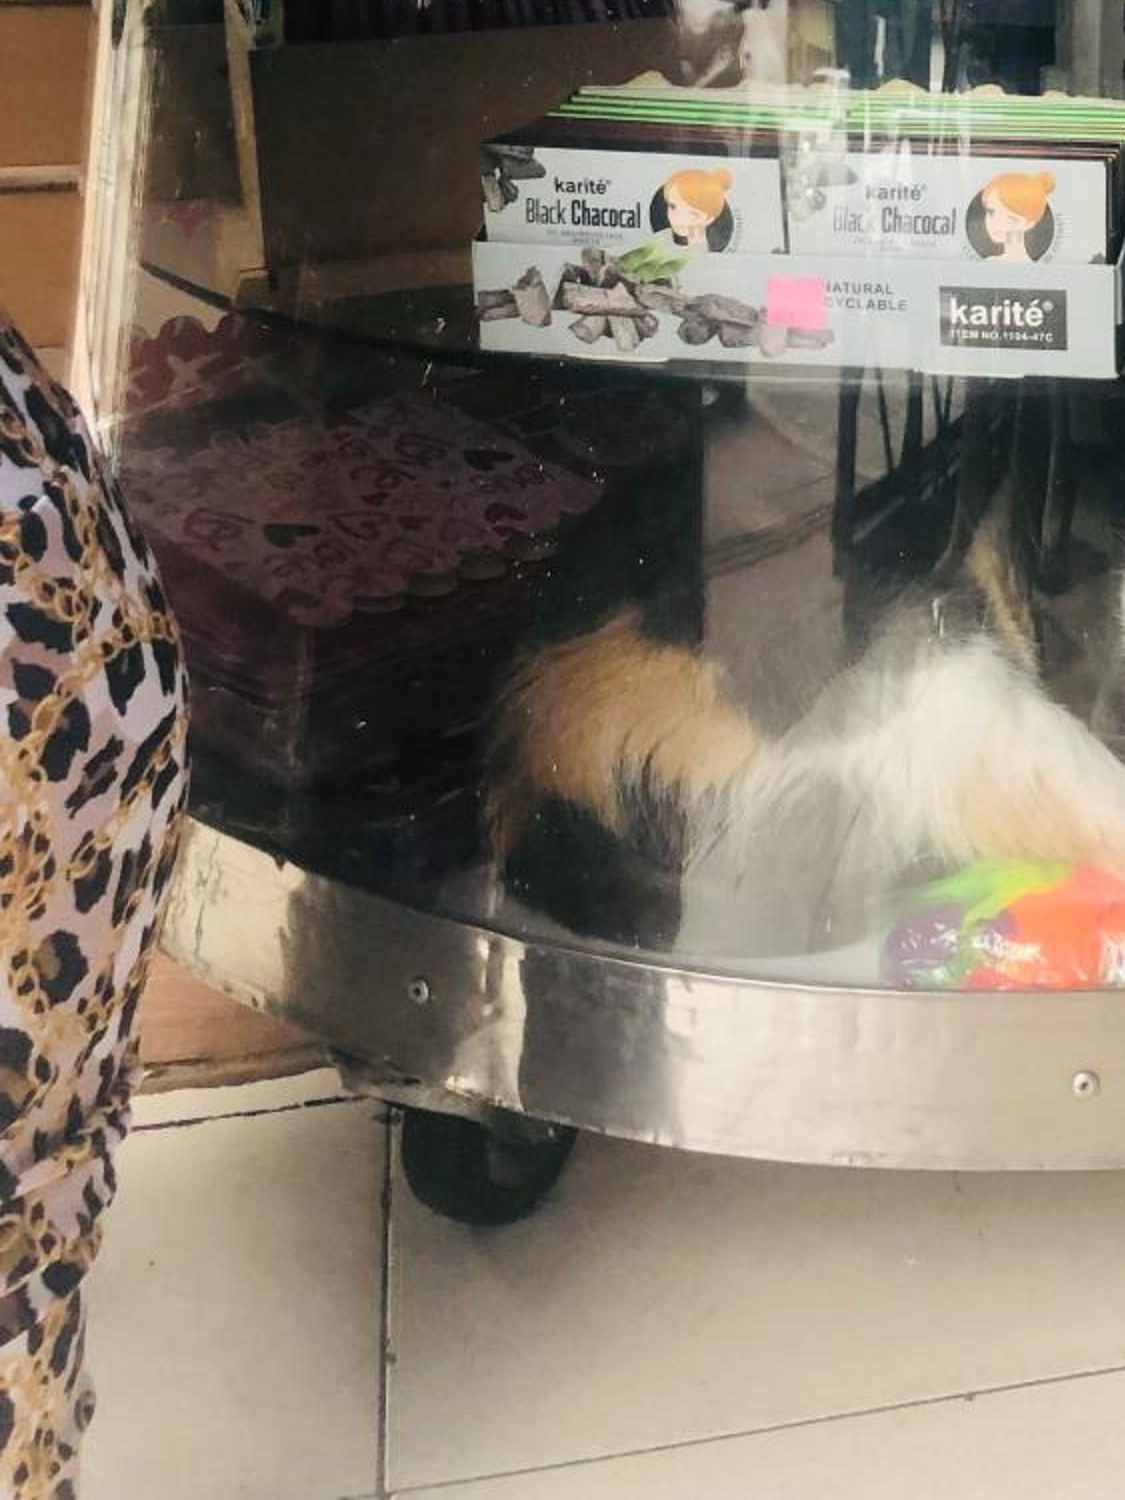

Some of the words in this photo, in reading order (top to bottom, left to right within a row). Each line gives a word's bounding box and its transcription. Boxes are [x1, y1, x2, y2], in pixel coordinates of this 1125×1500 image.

[525, 198, 567, 225] Black
[571, 200, 641, 229] Chacocal
[881, 206, 957, 236] Chacocal
